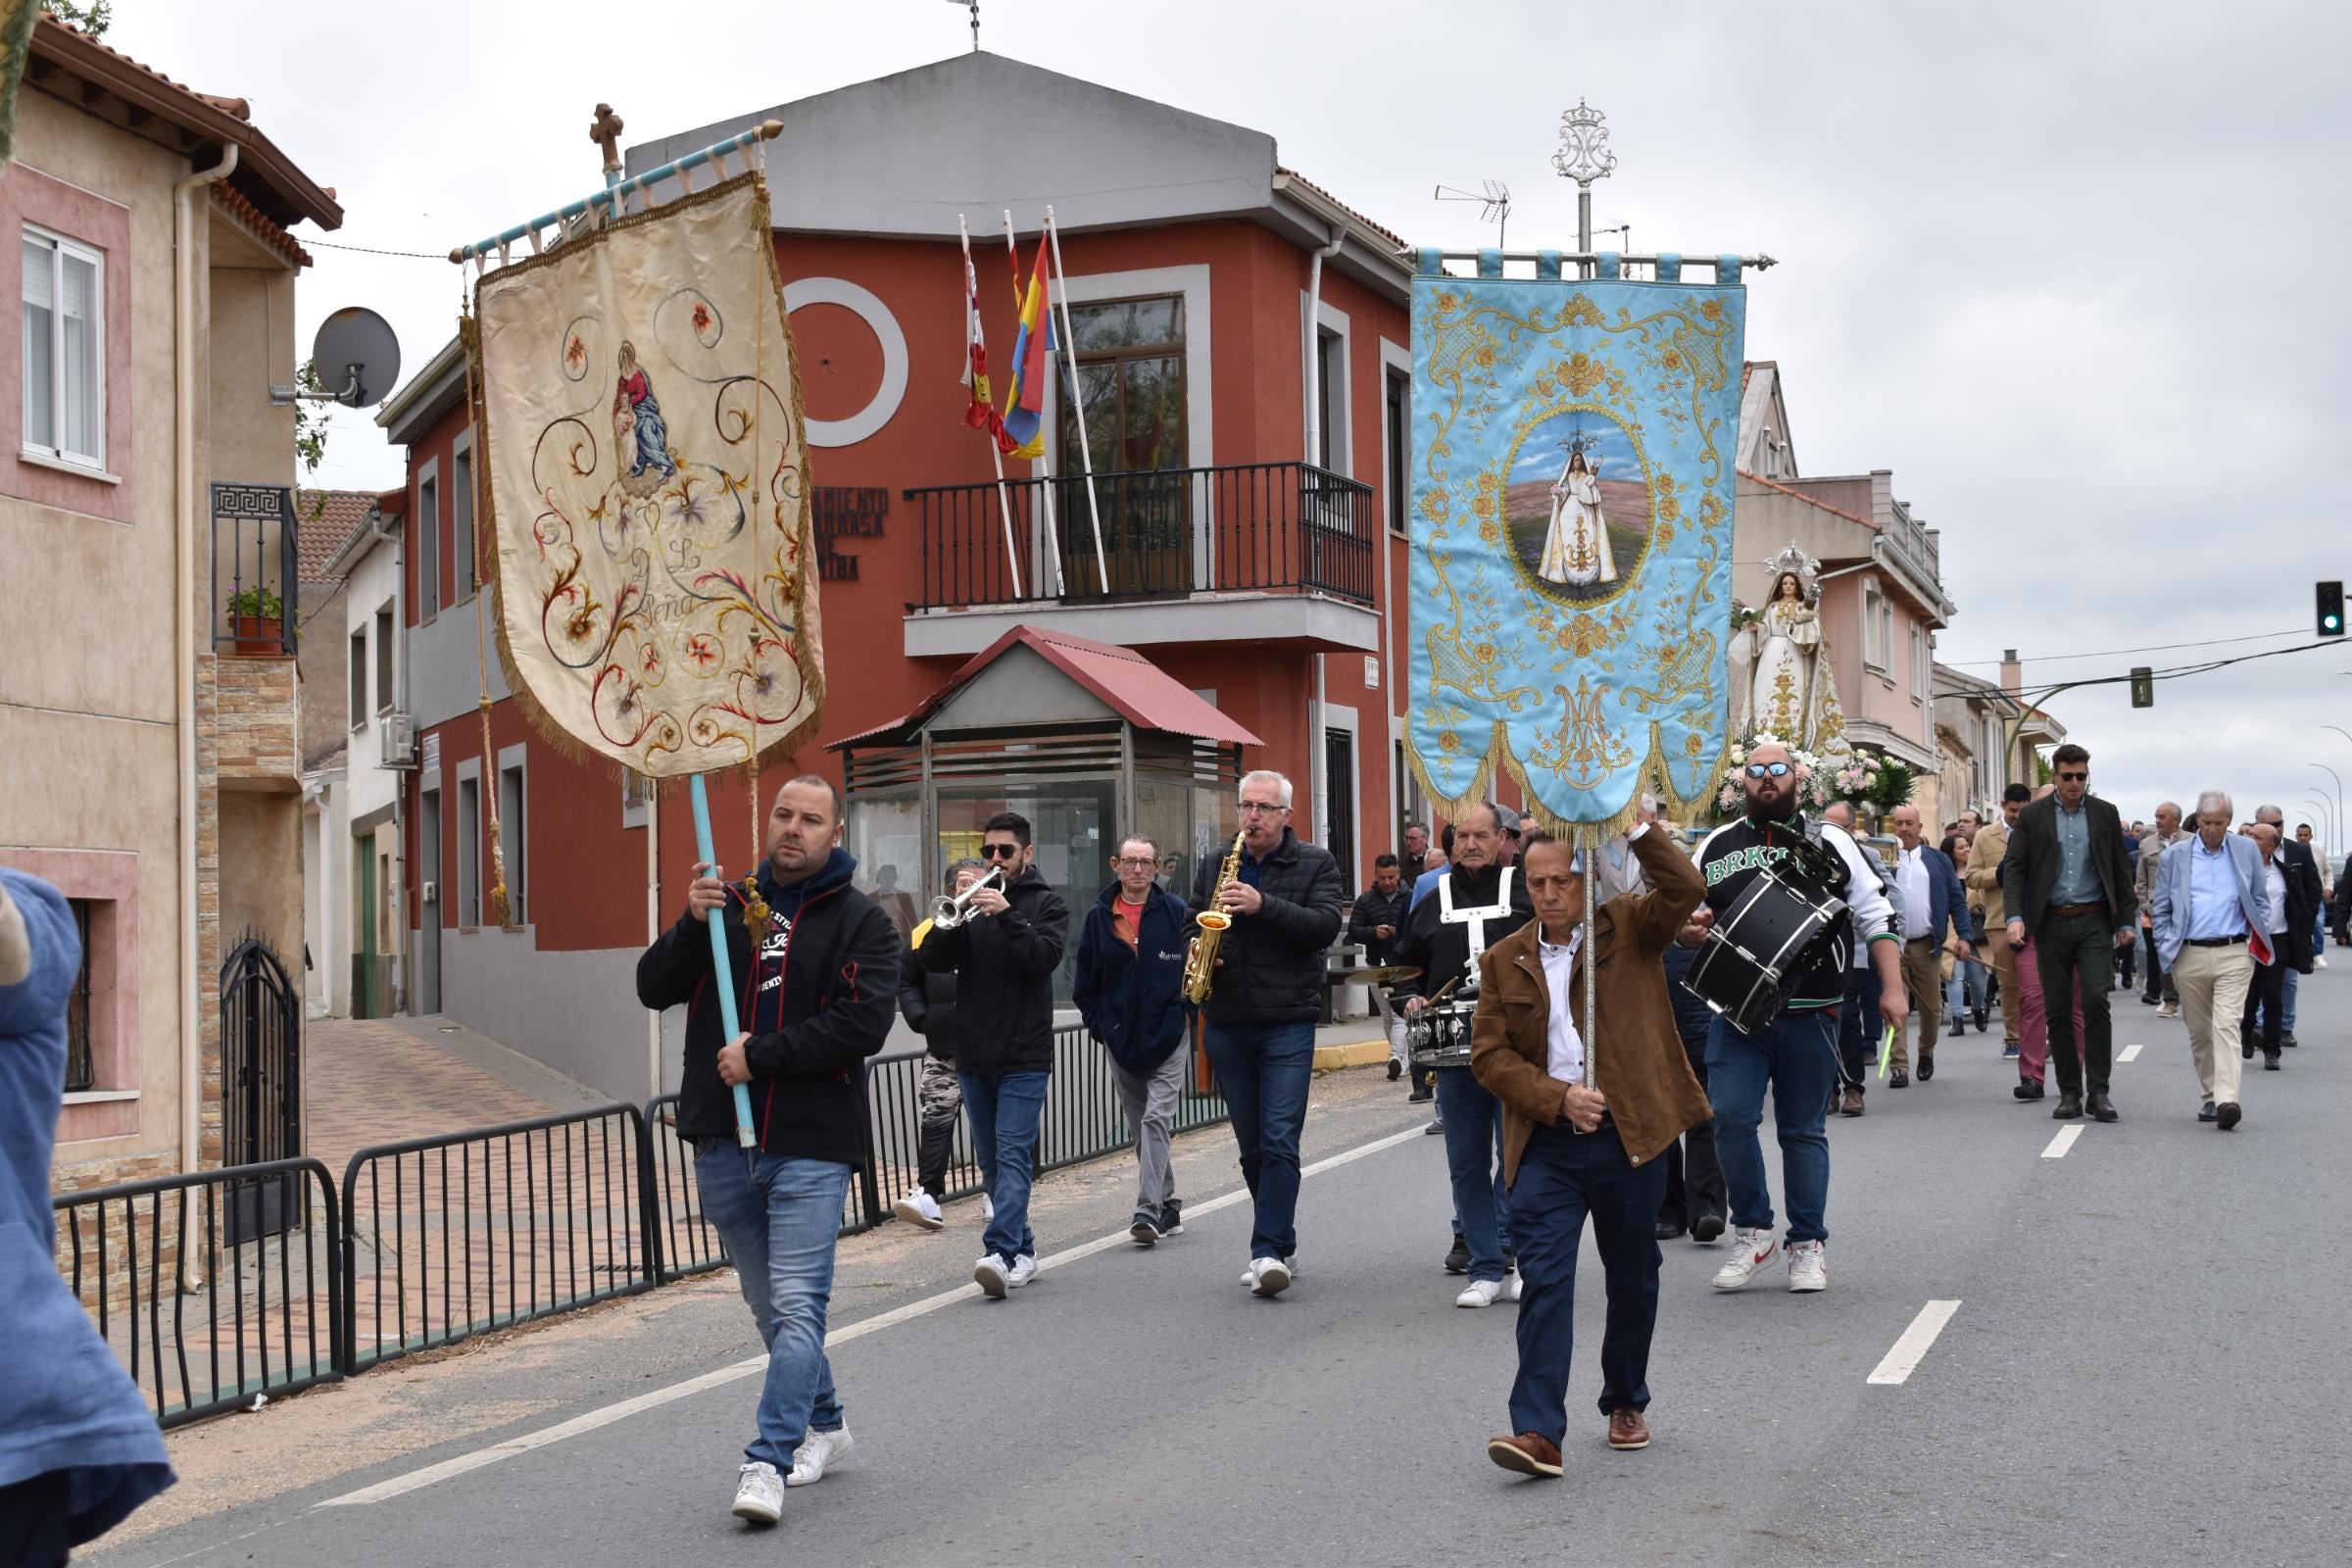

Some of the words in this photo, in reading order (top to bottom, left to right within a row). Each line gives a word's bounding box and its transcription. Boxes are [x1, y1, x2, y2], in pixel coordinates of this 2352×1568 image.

[811, 487, 889, 514] AMIENTO
[641, 594, 694, 631] Peña
[773, 911, 793, 930] STYL
